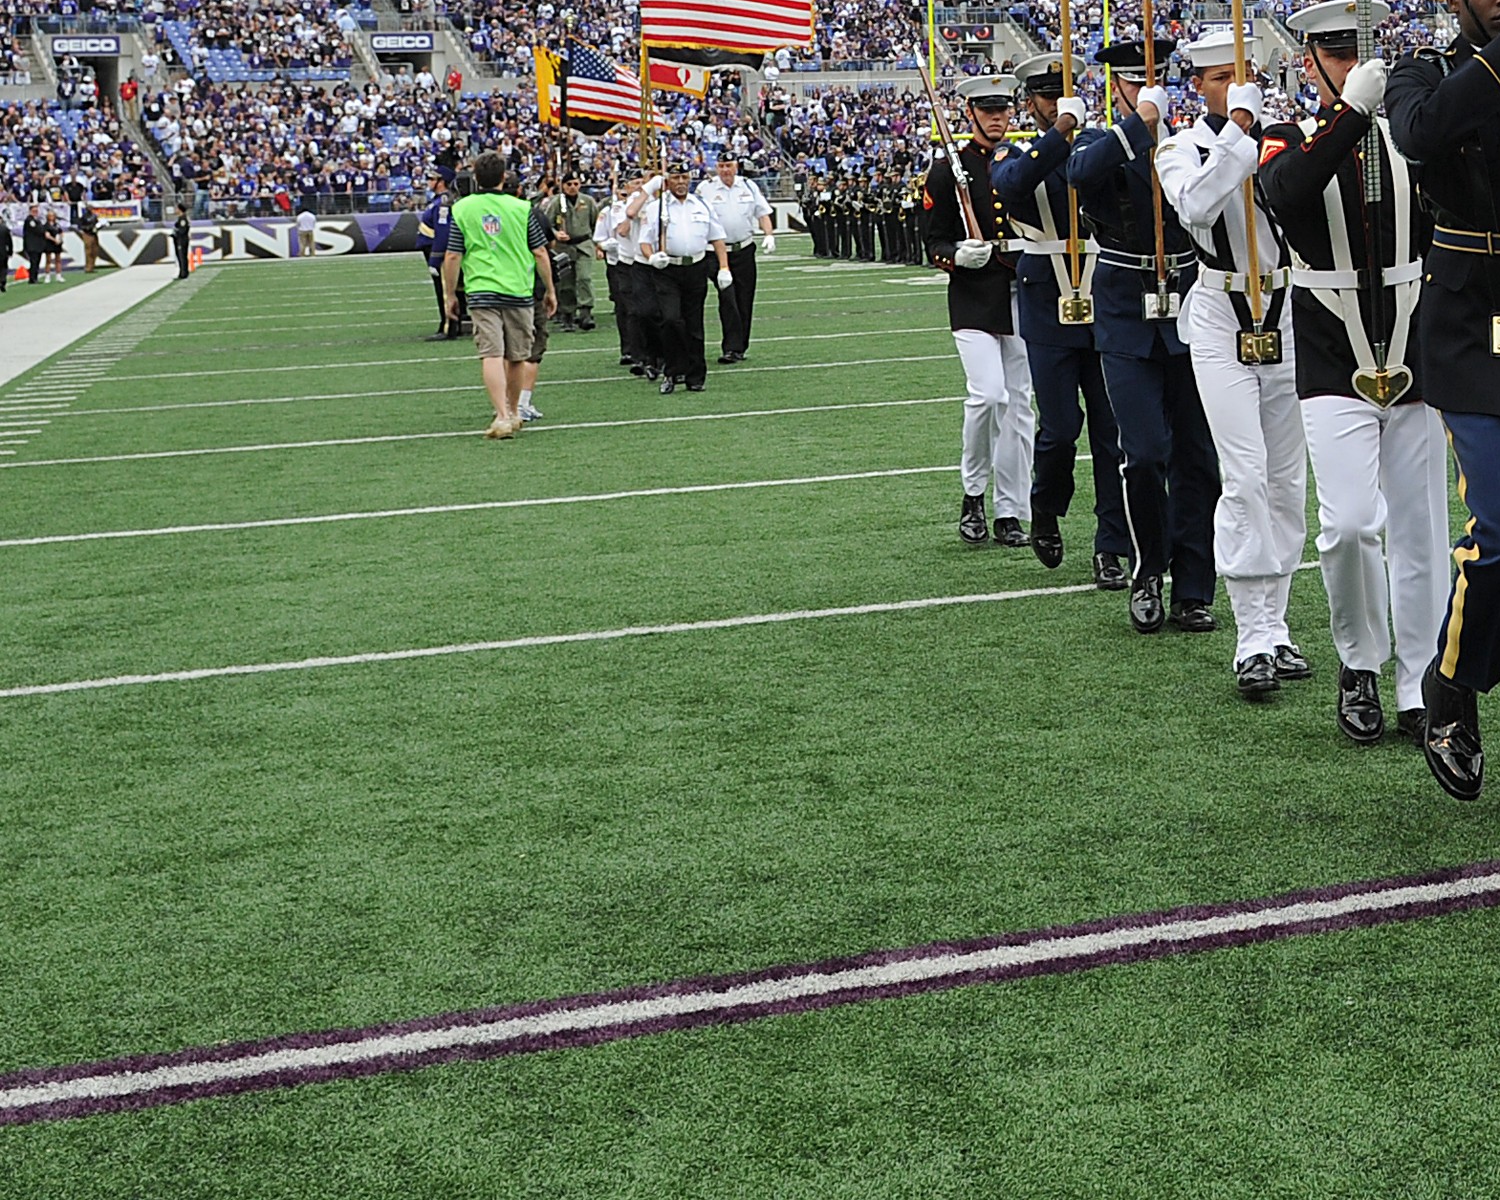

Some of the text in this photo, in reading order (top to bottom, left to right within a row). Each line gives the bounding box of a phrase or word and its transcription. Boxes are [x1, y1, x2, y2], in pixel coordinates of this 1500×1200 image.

[53, 38, 118, 53] GEICO
[372, 35, 432, 50] GEICO
[482, 221, 501, 235] NFL
